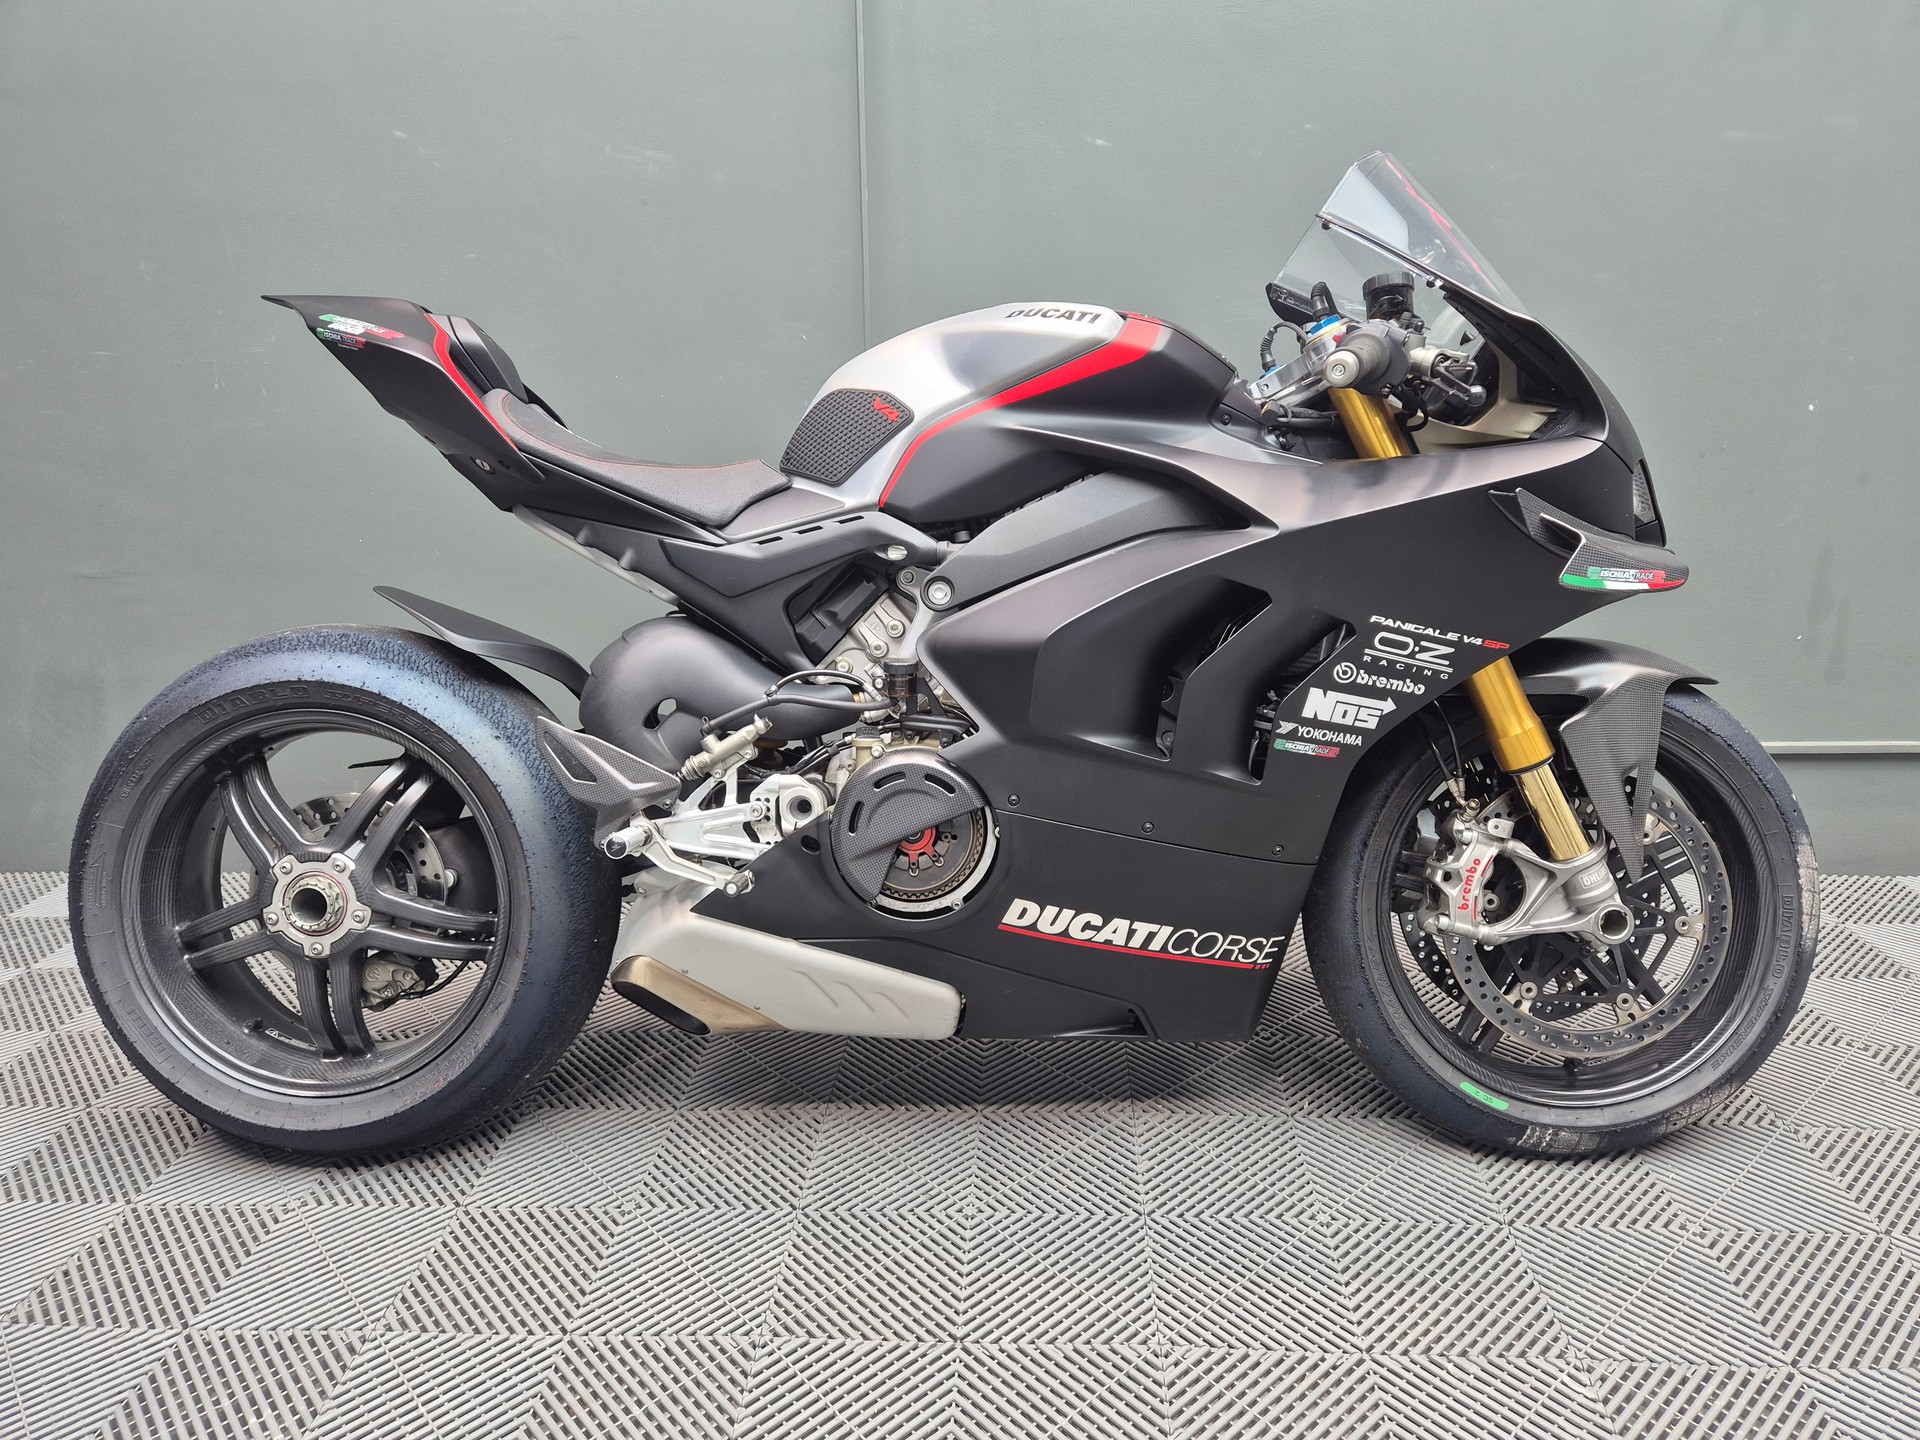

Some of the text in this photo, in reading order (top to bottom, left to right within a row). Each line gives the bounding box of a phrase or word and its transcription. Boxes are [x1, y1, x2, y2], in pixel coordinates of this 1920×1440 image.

[1005, 307, 1102, 324] DUCATI
[874, 397, 900, 422] V4
[1600, 570, 1630, 579] ISCHIA
[1370, 615, 1461, 641] PANIGALE
[1363, 655, 1449, 680] RACING
[1356, 669, 1425, 695] brembo
[194, 685, 309, 724] DIABLO
[1297, 725, 1363, 746] YOKOHAMA
[1457, 858, 1482, 911] brembo
[1001, 898, 1286, 964] DUCATI CORSE
[1773, 895, 1795, 979] DIABLO
